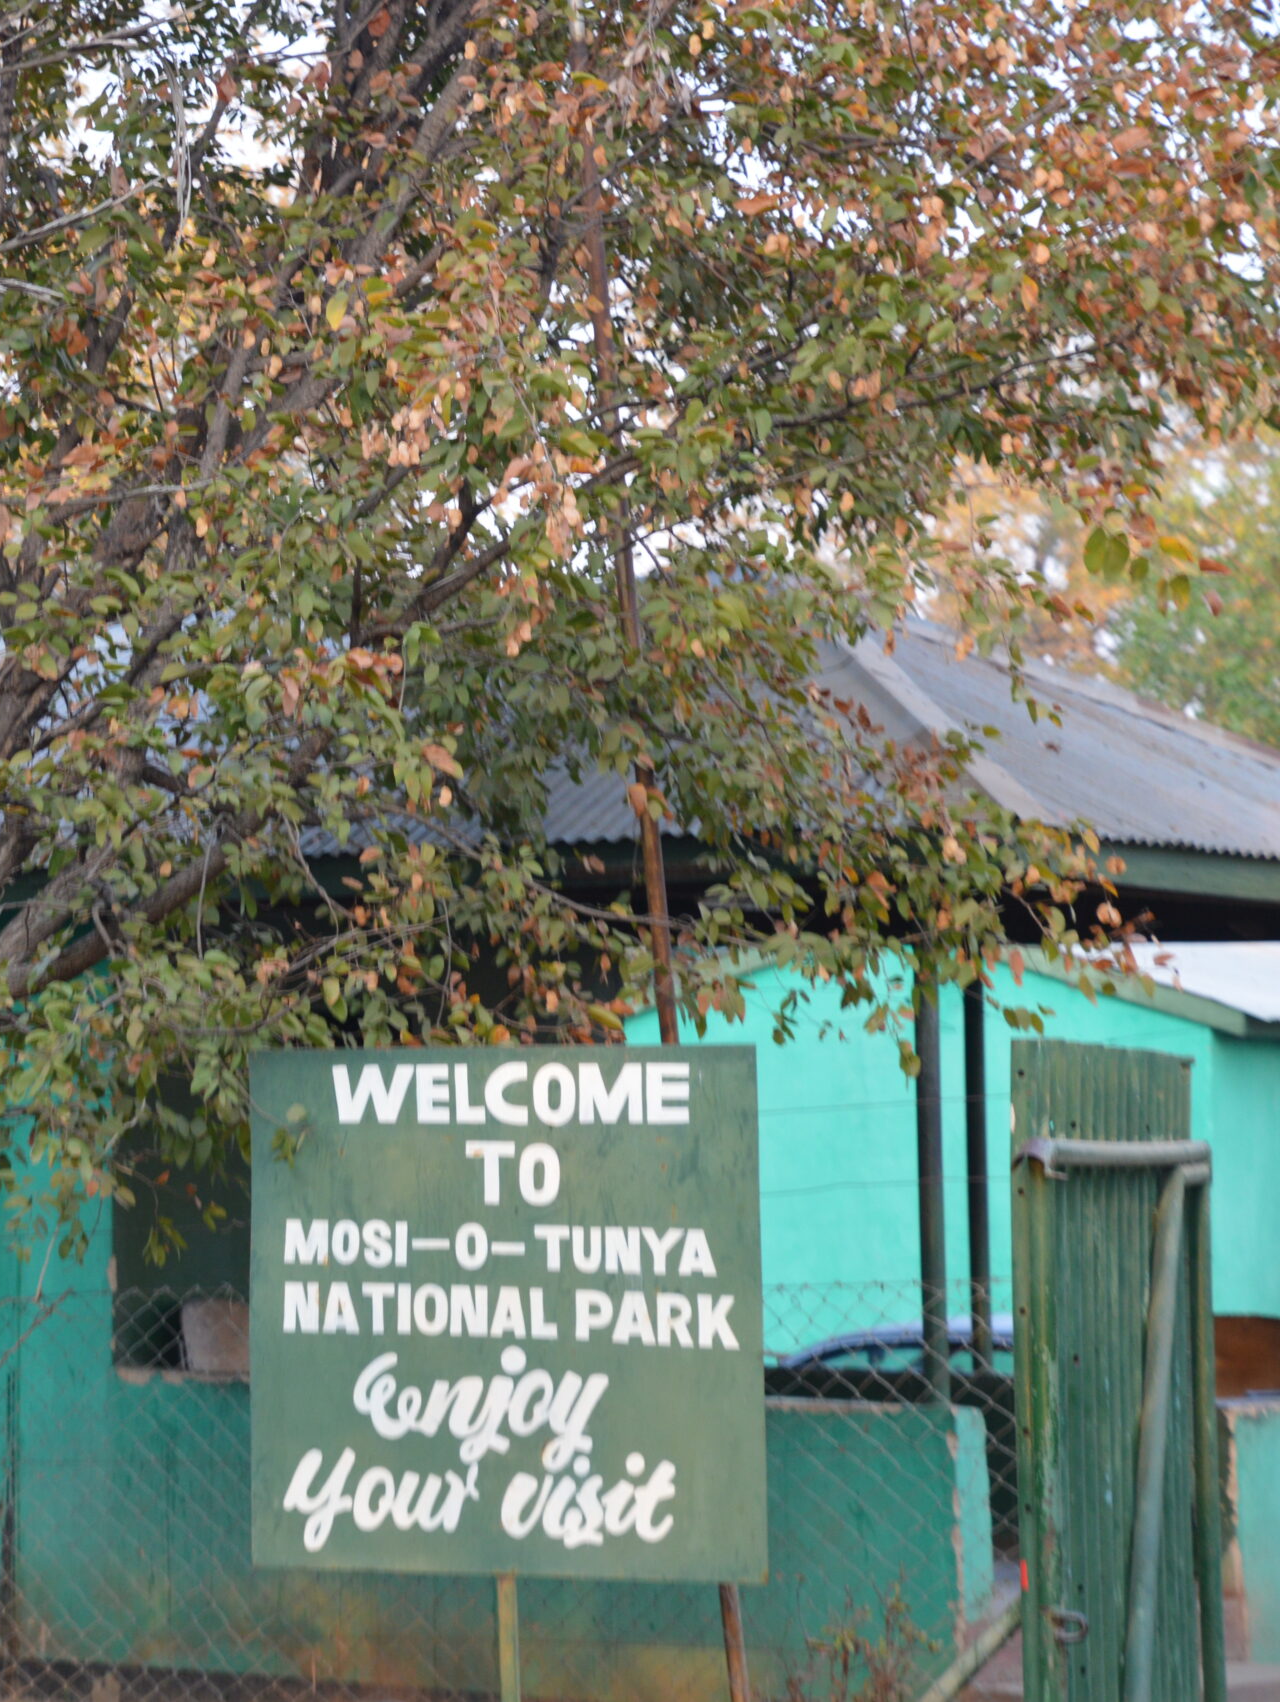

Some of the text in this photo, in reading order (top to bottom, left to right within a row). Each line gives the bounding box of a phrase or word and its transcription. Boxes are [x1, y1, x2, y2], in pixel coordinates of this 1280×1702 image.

[331, 1060, 691, 1128] WELCOME
[464, 1139, 562, 1207] TO
[282, 1280, 741, 1351] NATIONAL PARK
[352, 1345, 610, 1472] Enjoy
[500, 1451, 677, 1549] visit
